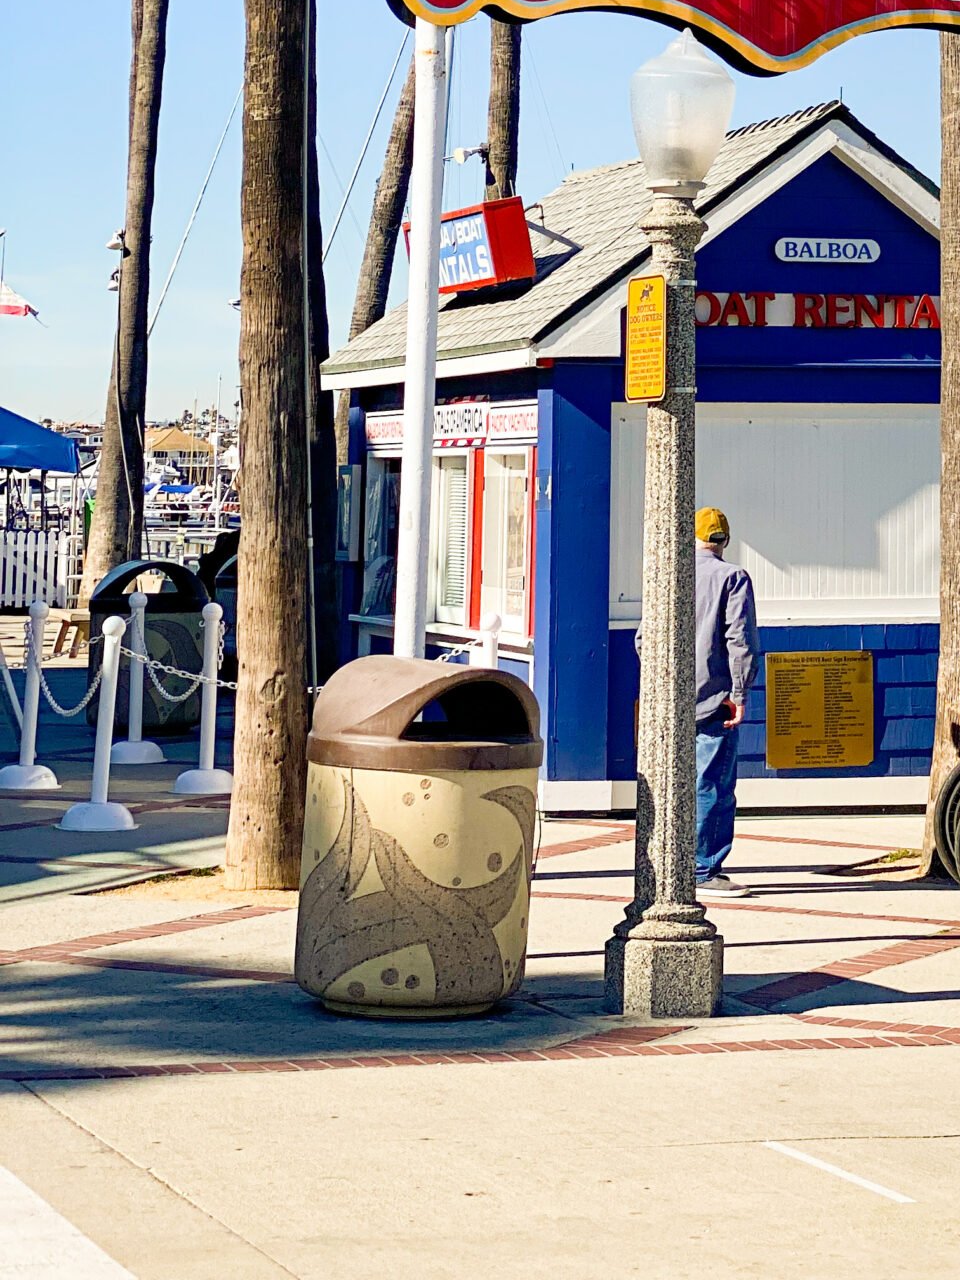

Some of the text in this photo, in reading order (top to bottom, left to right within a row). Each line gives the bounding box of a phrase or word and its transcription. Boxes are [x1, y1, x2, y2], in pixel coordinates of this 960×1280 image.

[455, 218, 483, 245] BOAT
[783, 241, 872, 260] BALBOA
[438, 245, 491, 288] NTALS
[694, 292, 941, 328] OAT RENTA
[434, 411, 450, 434] NTALS
